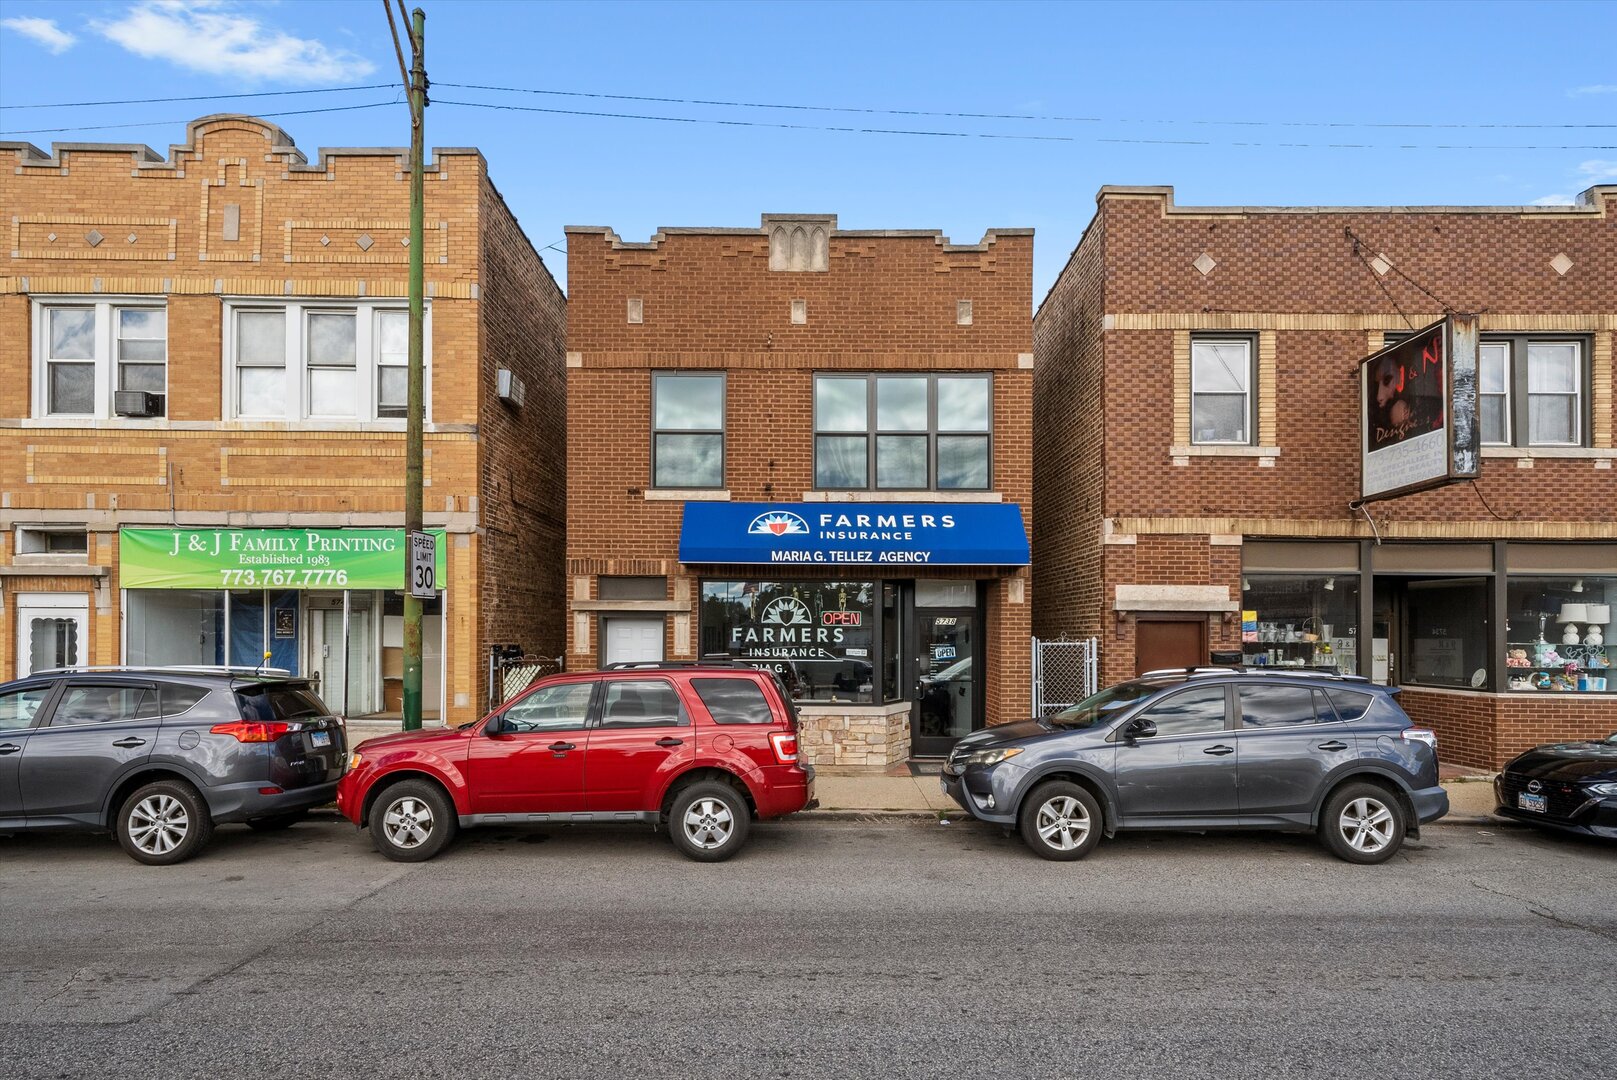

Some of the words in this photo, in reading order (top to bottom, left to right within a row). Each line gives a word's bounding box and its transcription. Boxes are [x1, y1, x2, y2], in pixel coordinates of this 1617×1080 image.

[1396, 365, 1405, 392] J
[1409, 367, 1417, 380] &
[1422, 336, 1439, 374] N
[820, 514, 956, 528] FARMERS
[820, 531, 913, 541] INSURANCE
[169, 533, 181, 556] J
[188, 534, 207, 552] &
[210, 533, 222, 556] J
[229, 533, 300, 552] FAMILY
[306, 533, 395, 552] PRINTING
[414, 536, 434, 550] SPEED
[239, 553, 303, 565] Established
[307, 556, 330, 567] 1983
[416, 551, 432, 563] LIMIT
[771, 550, 812, 562] MARIA
[814, 551, 827, 562] G.
[829, 551, 873, 562] TELLEZ
[879, 551, 931, 562] AGENCY
[220, 569, 348, 586] 773.767.7776
[415, 564, 433, 589] 30
[823, 612, 861, 625] OPEN
[936, 617, 957, 626] 5738
[732, 627, 844, 643] FARMERS
[749, 648, 825, 658] INSURANCE
[937, 647, 954, 658] OPEN
[775, 663, 787, 674] G.
